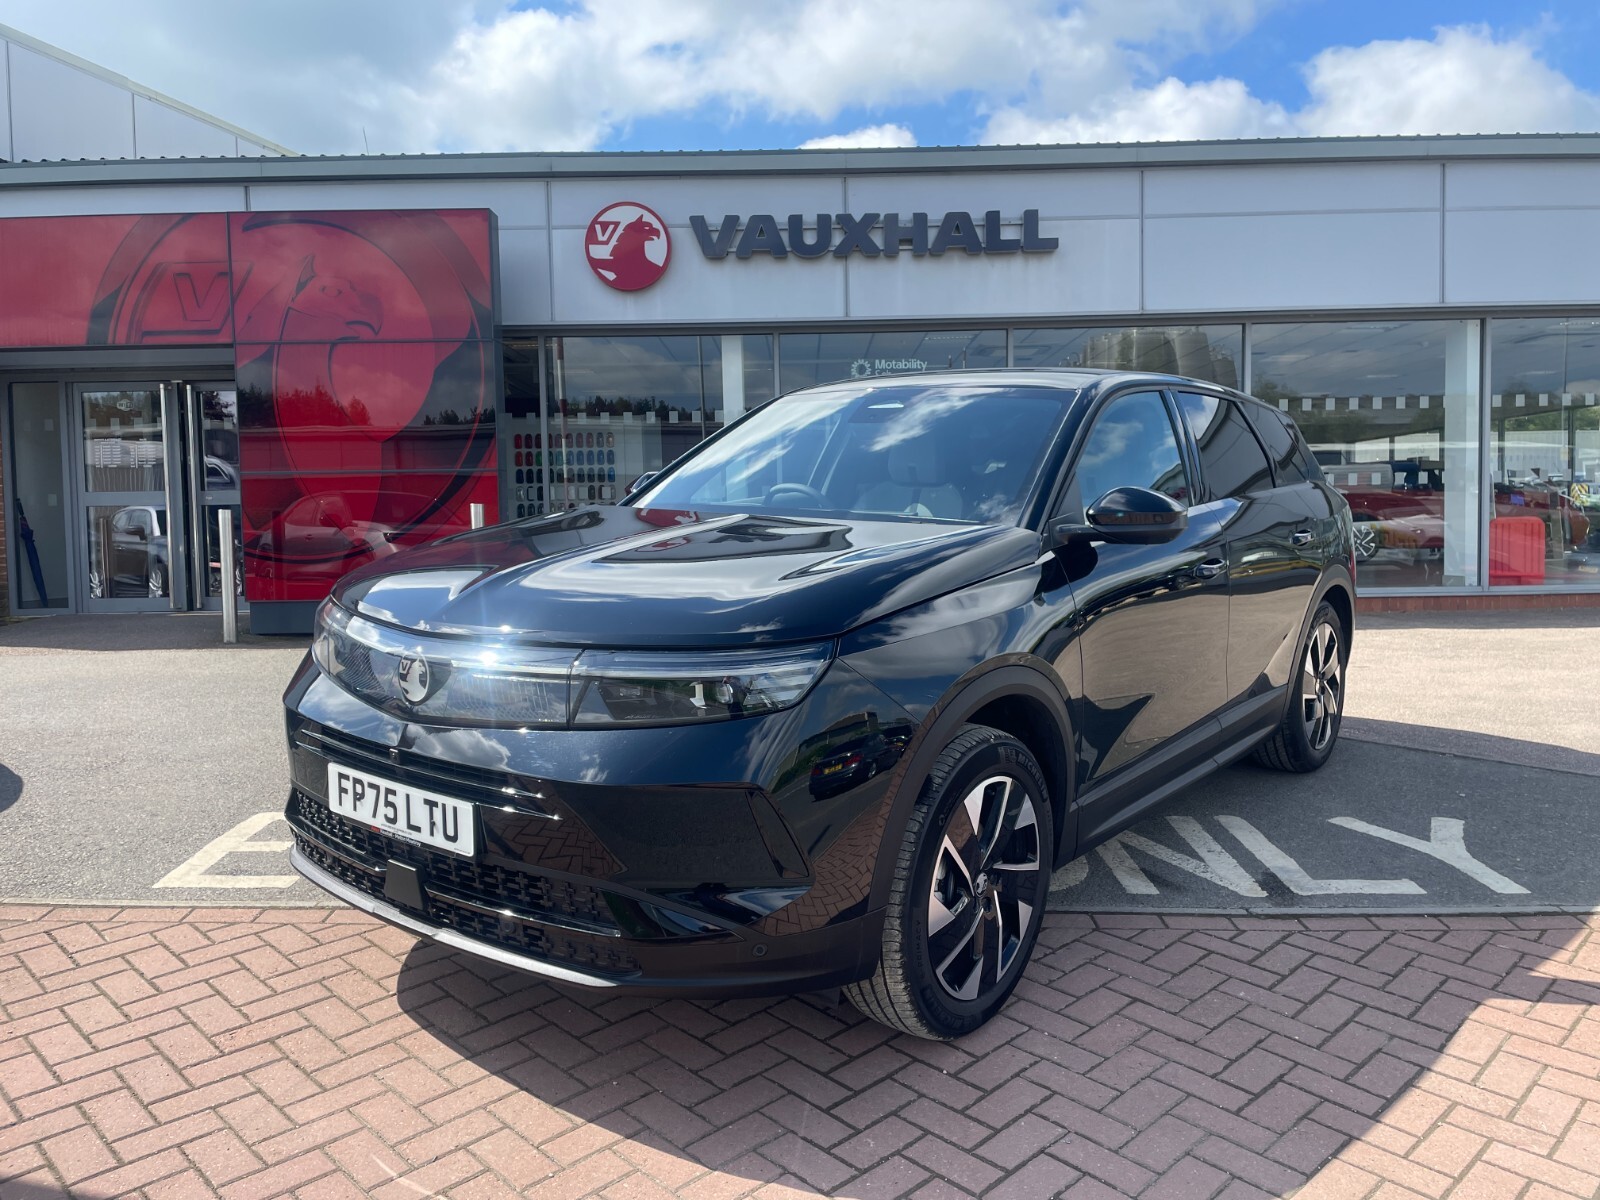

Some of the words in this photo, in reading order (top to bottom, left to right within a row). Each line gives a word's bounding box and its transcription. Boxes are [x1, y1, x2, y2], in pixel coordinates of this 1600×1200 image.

[689, 209, 1059, 258] VAUXHALL
[875, 358, 928, 372] Motability
[1017, 752, 1049, 800] MICHELIN
[338, 771, 398, 825] FP75
[406, 793, 459, 843] LTU
[1049, 815, 1532, 897] NLY
